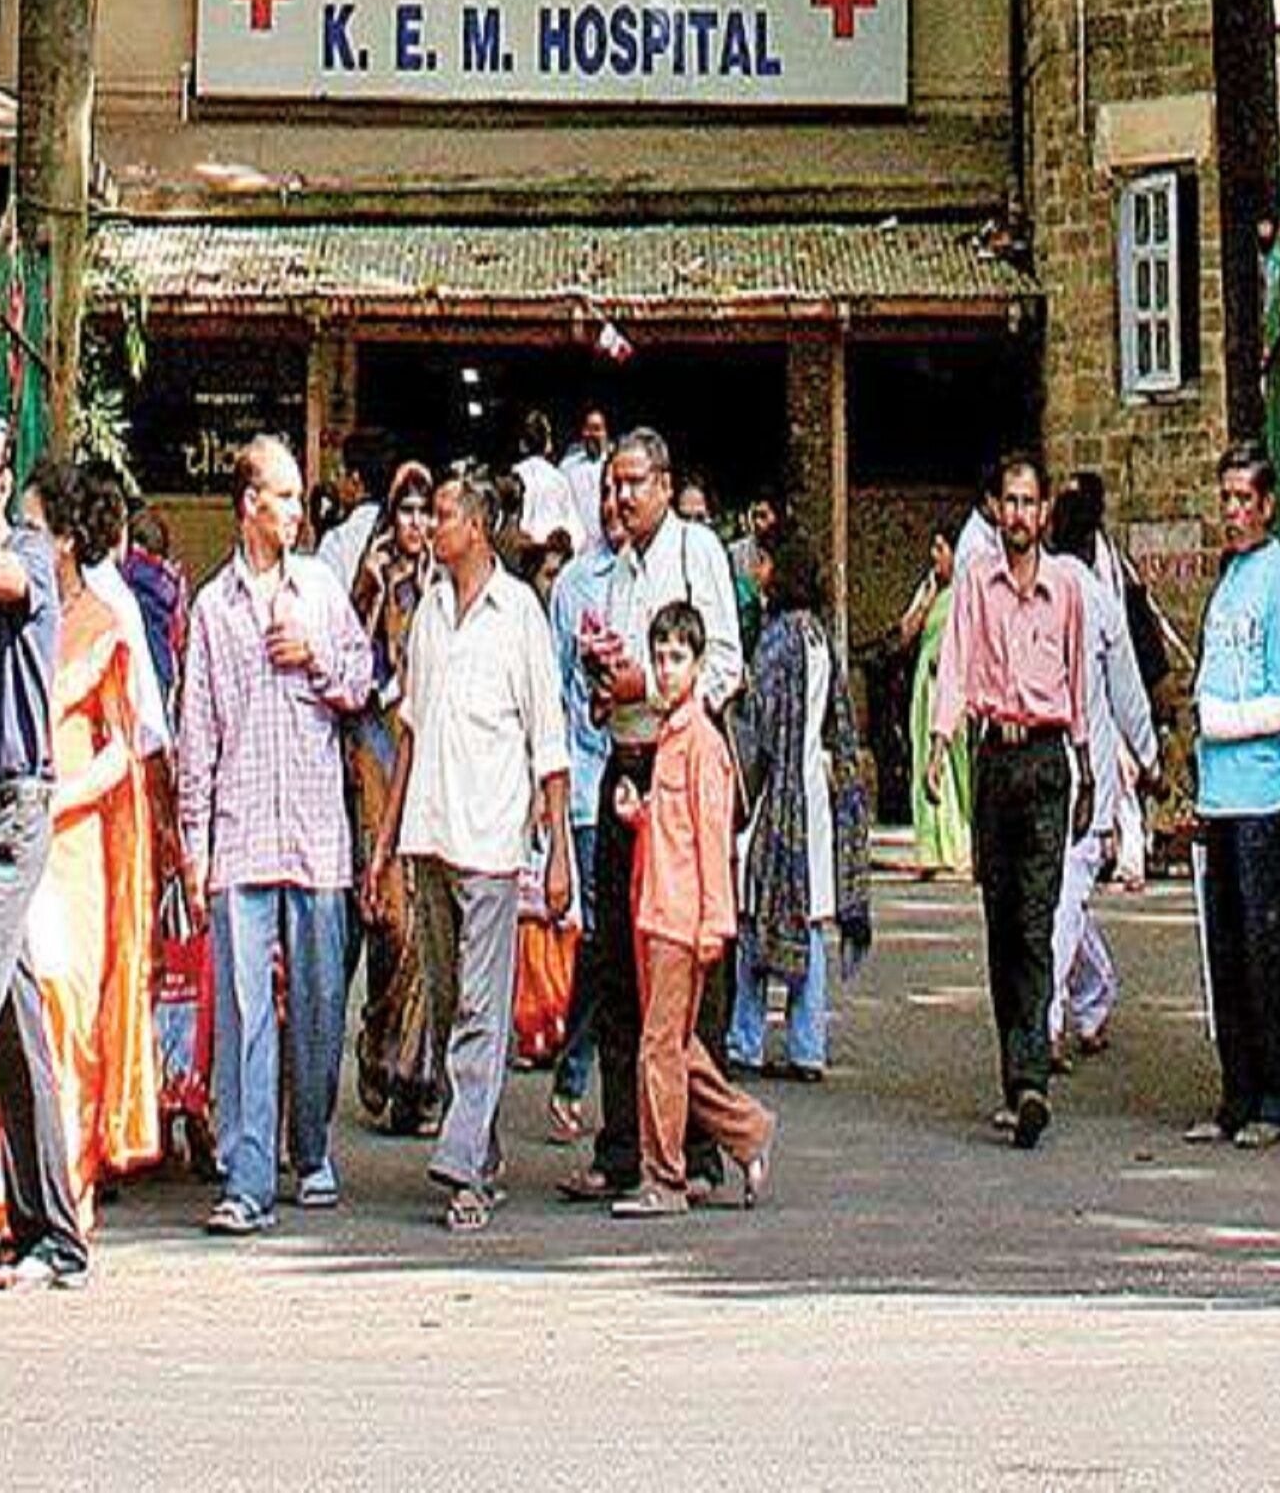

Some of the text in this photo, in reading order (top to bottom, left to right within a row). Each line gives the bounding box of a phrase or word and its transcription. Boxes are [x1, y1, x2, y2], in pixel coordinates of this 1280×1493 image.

[323, 4, 782, 76] K. E. M. HOSPITAL
